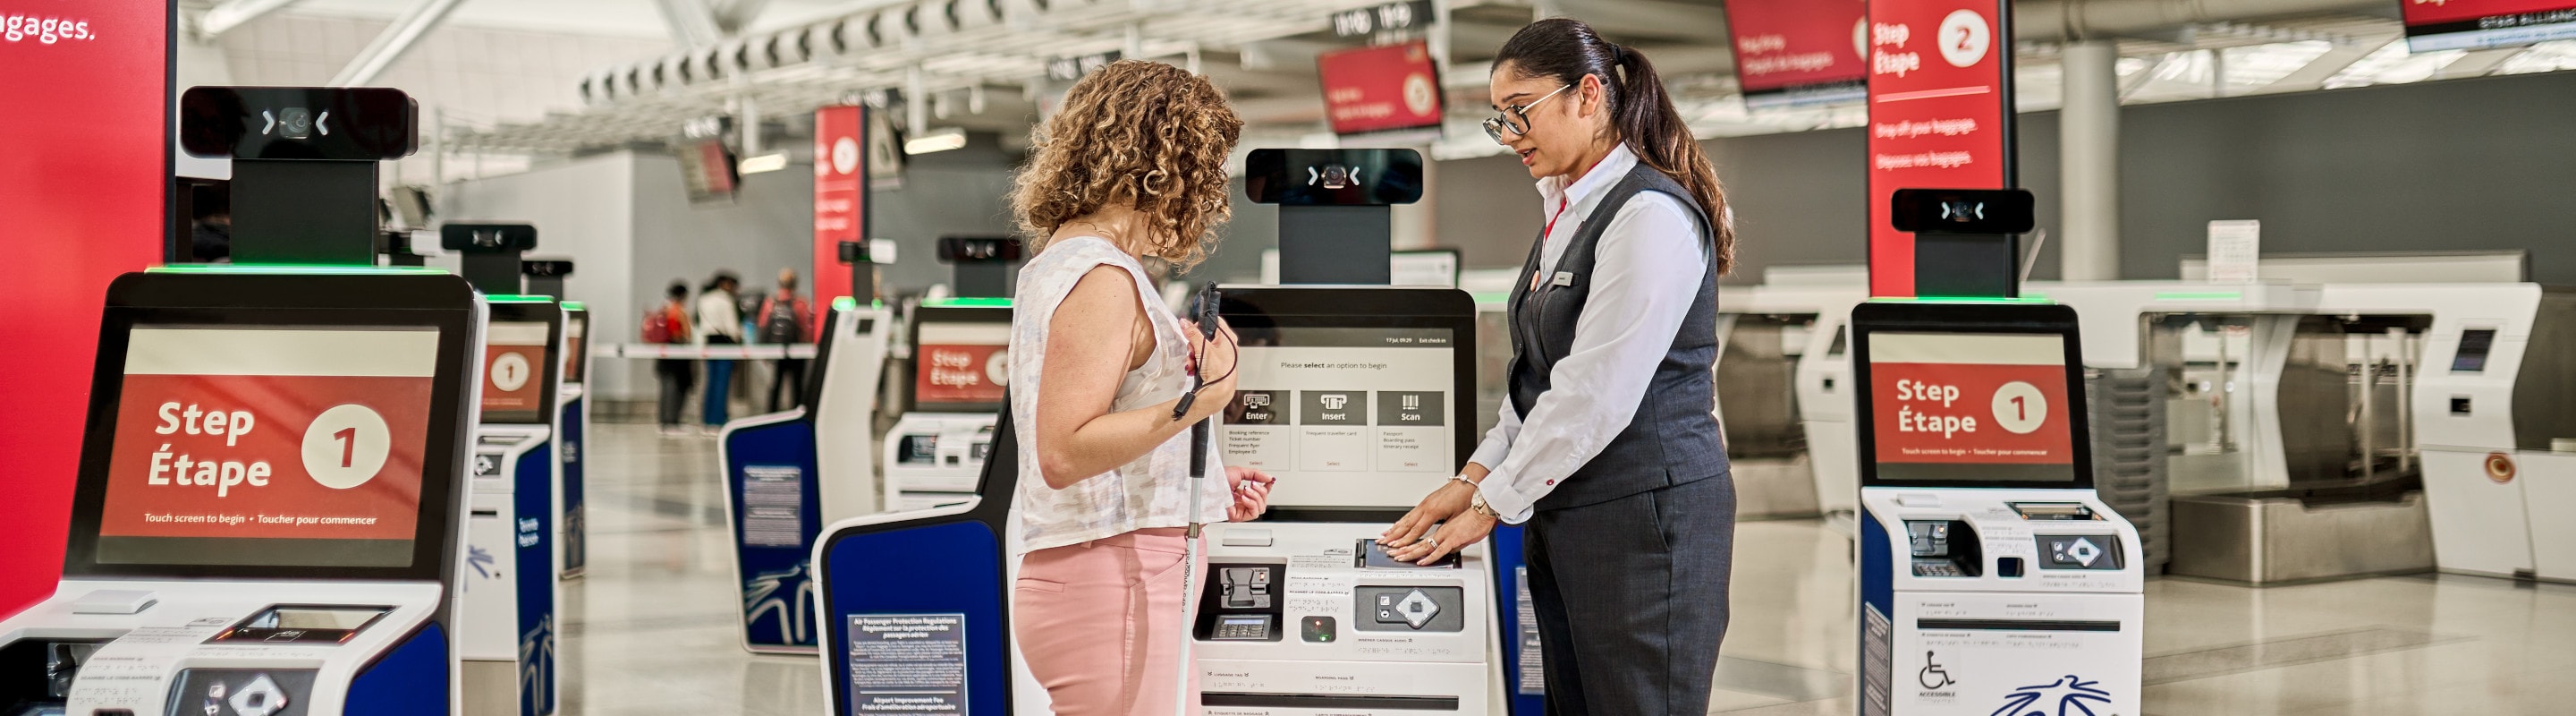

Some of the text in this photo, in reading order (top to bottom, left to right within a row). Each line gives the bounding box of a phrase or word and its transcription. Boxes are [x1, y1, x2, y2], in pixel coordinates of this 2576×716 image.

[0, 15, 95, 44] gages.
[1873, 22, 1910, 48] Step
[1956, 26, 1973, 52] 2
[1873, 47, 1920, 78] Étape
[505, 362, 515, 379] 1
[1336, 362, 1358, 371] option
[1368, 362, 1387, 371] begin
[1896, 379, 1960, 408] Step
[1322, 413, 1345, 421] Insert
[1401, 413, 1420, 421] Scan
[1898, 405, 1977, 439] Étape
[2010, 396, 2026, 422] 1
[155, 401, 255, 446] Step
[333, 427, 356, 468] 1
[1949, 448, 1966, 457] begin
[1997, 449, 2012, 457] pour
[148, 443, 272, 498] Étape
[144, 513, 377, 526] Touch screen to begin Toucher pour commencer
